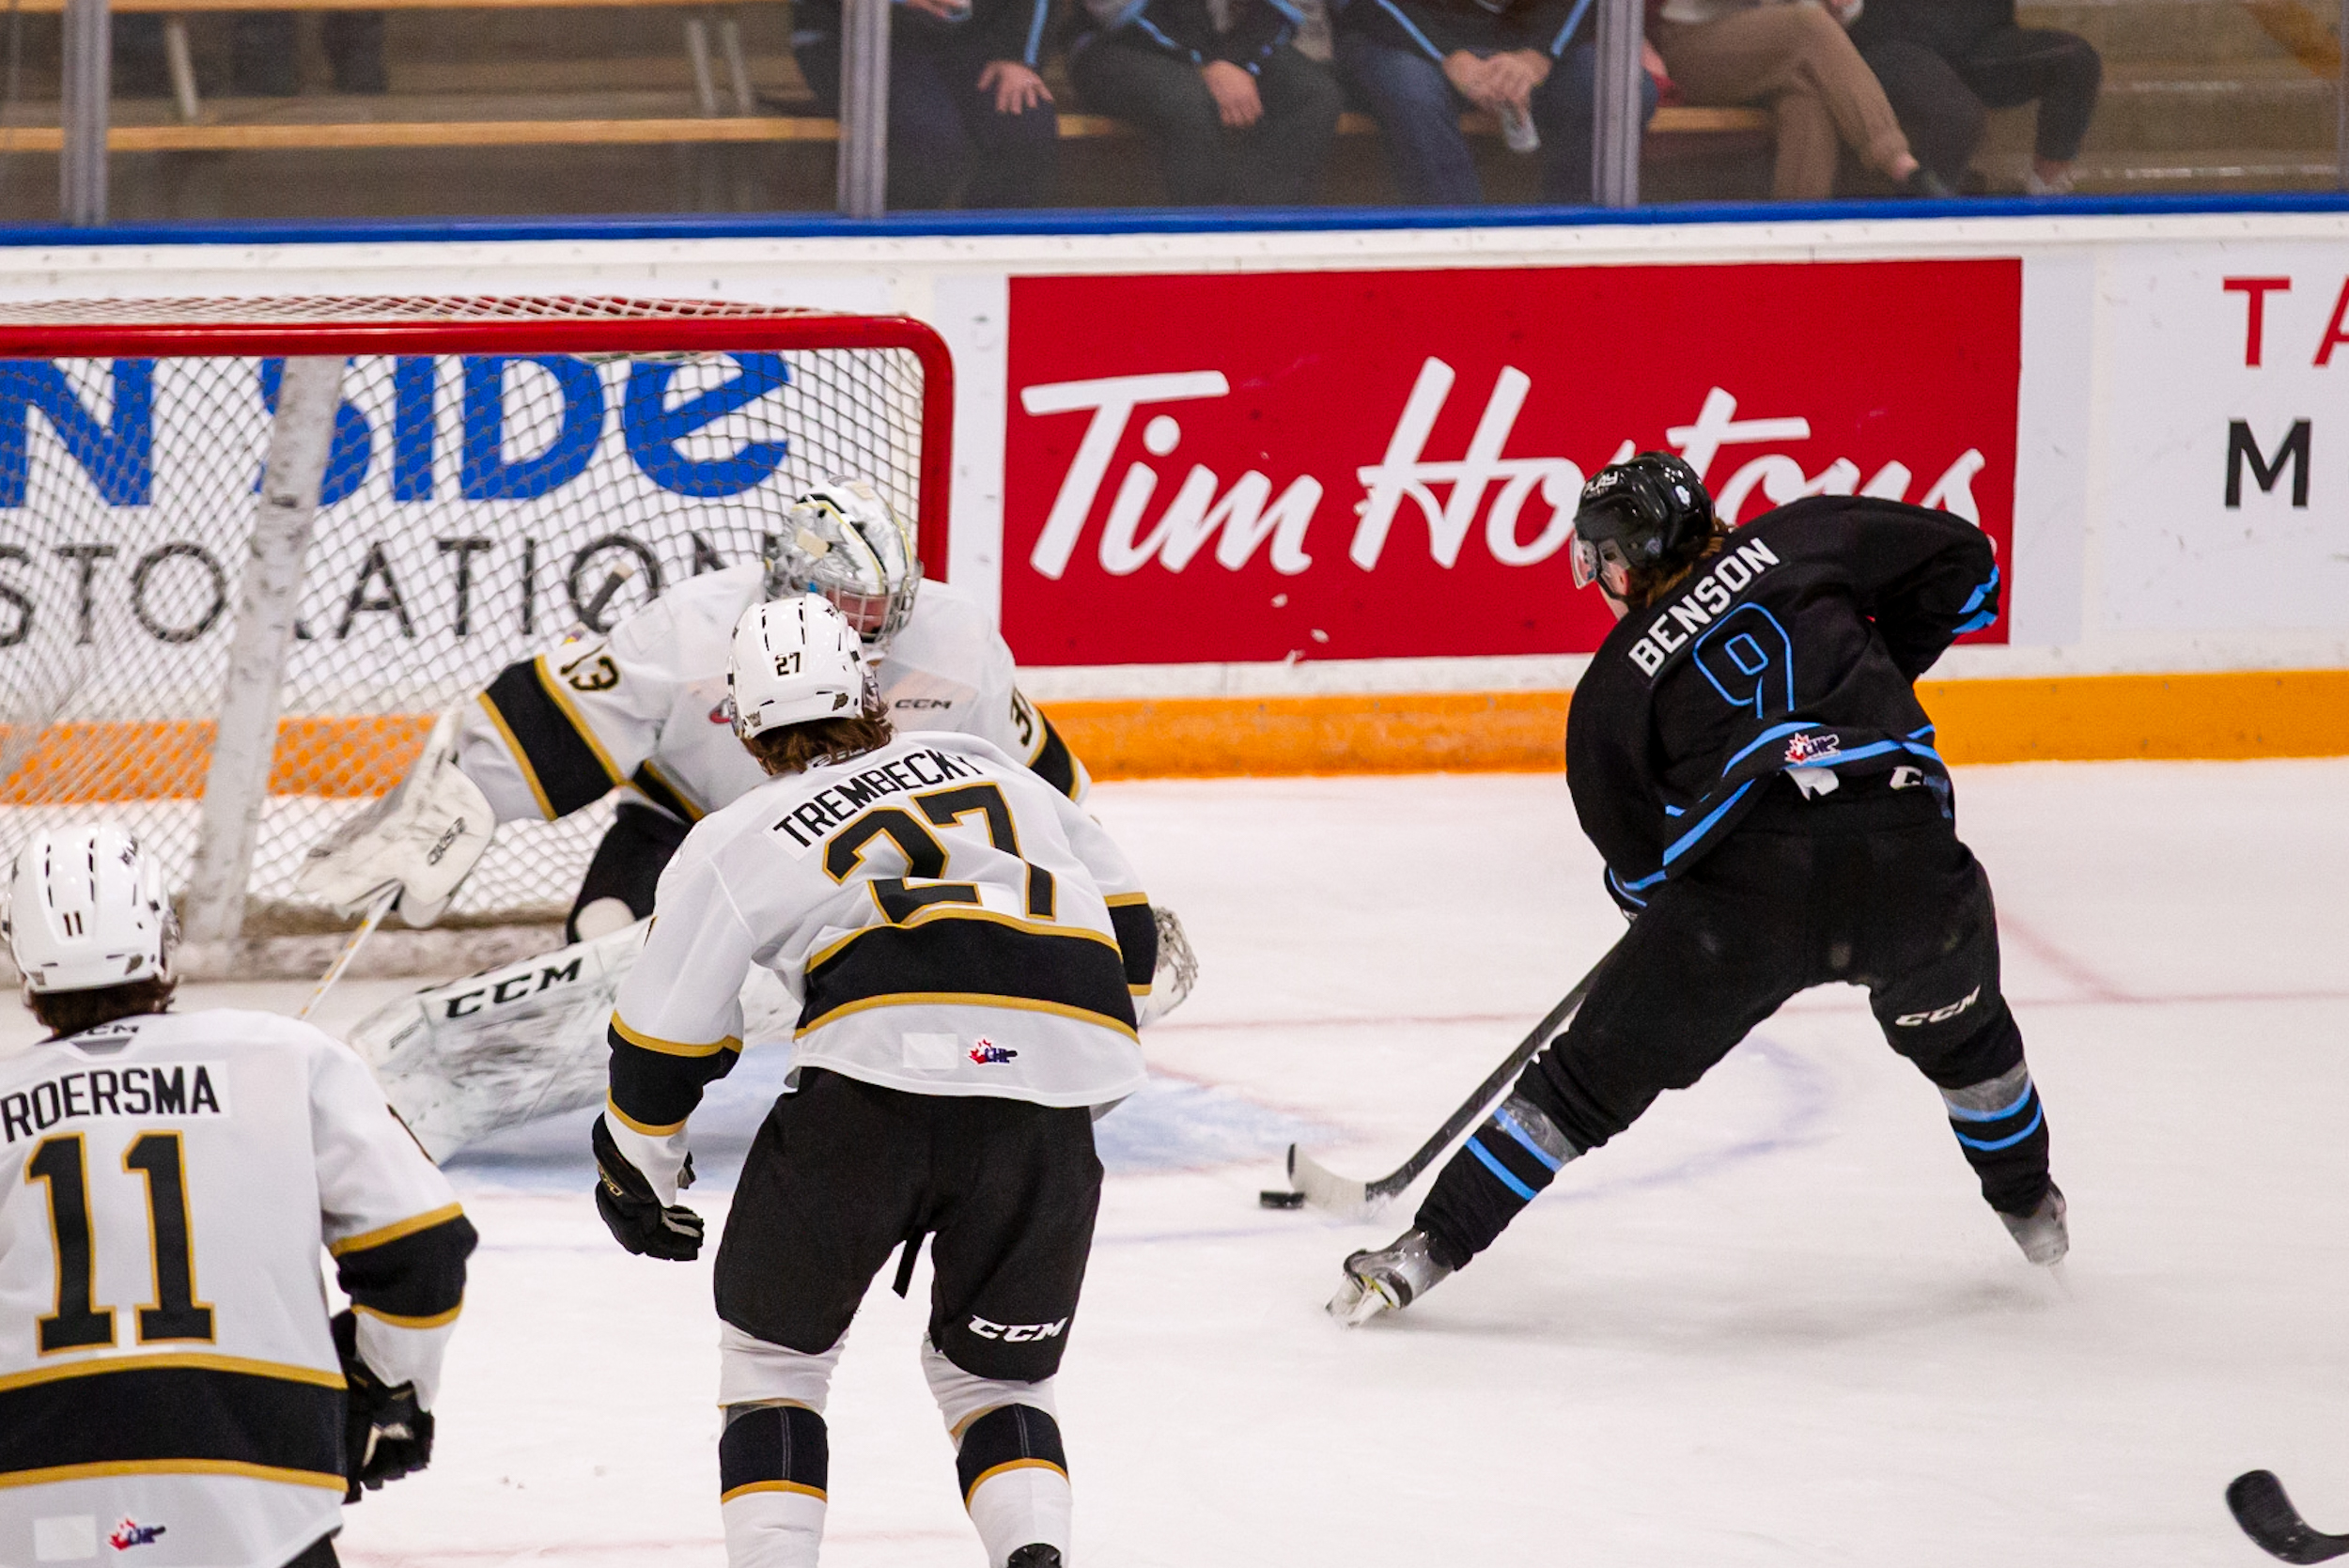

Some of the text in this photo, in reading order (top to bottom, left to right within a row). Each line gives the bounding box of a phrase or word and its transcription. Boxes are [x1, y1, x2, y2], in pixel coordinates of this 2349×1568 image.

[1019, 369, 1324, 580] Tim
[1628, 536, 1781, 678] BENSON
[774, 651, 801, 677] 27
[1691, 601, 1796, 720] 9
[894, 698, 953, 710] CCM
[772, 748, 984, 849] TREMBECKY
[821, 781, 1057, 925] 27
[62, 912, 84, 938] 11
[445, 956, 583, 1018] CCM
[1894, 985, 1982, 1028] CCM
[0, 1064, 222, 1144] ROERSMA
[23, 1128, 218, 1358] 11
[968, 1312, 1068, 1343] CCM
